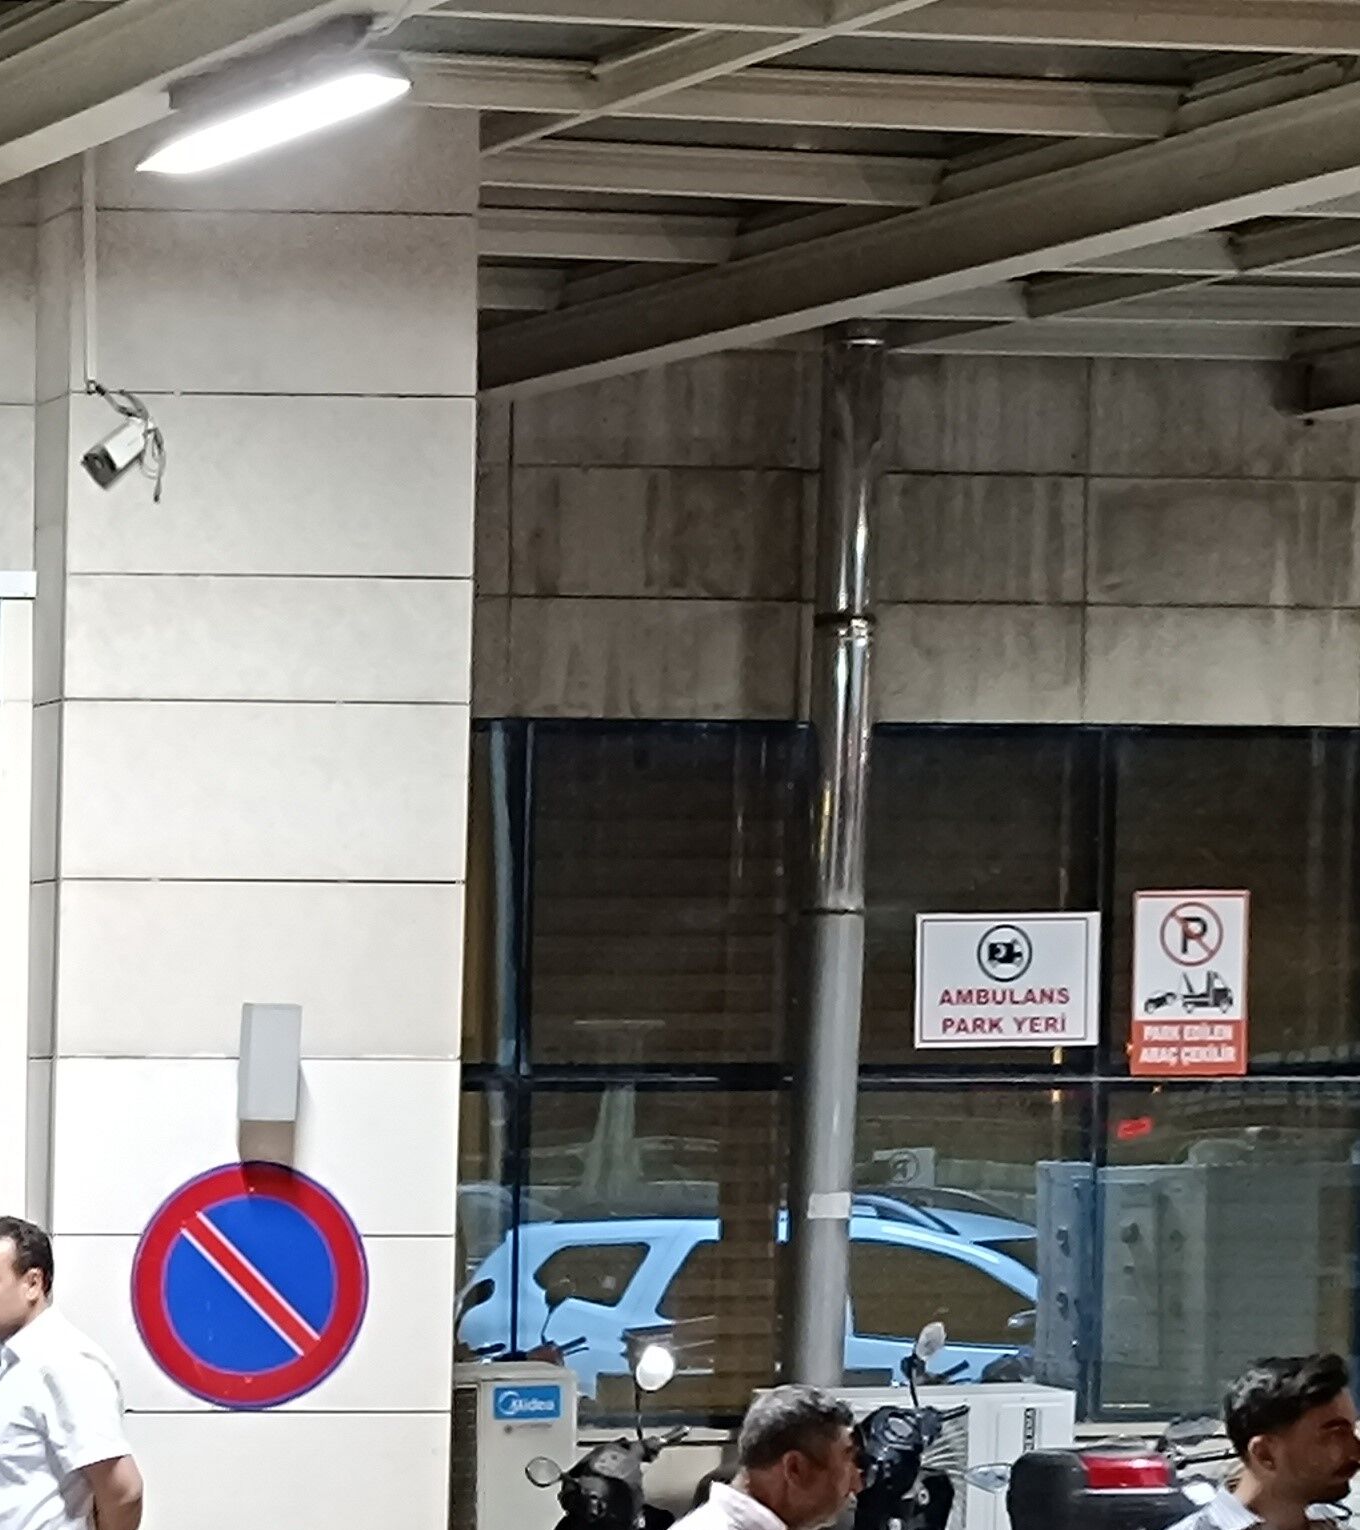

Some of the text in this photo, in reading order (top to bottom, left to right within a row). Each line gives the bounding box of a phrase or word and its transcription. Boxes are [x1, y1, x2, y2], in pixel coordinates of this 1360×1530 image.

[939, 987, 1071, 1006] AMBULANS
[941, 1013, 1067, 1035] PARK YERİ
